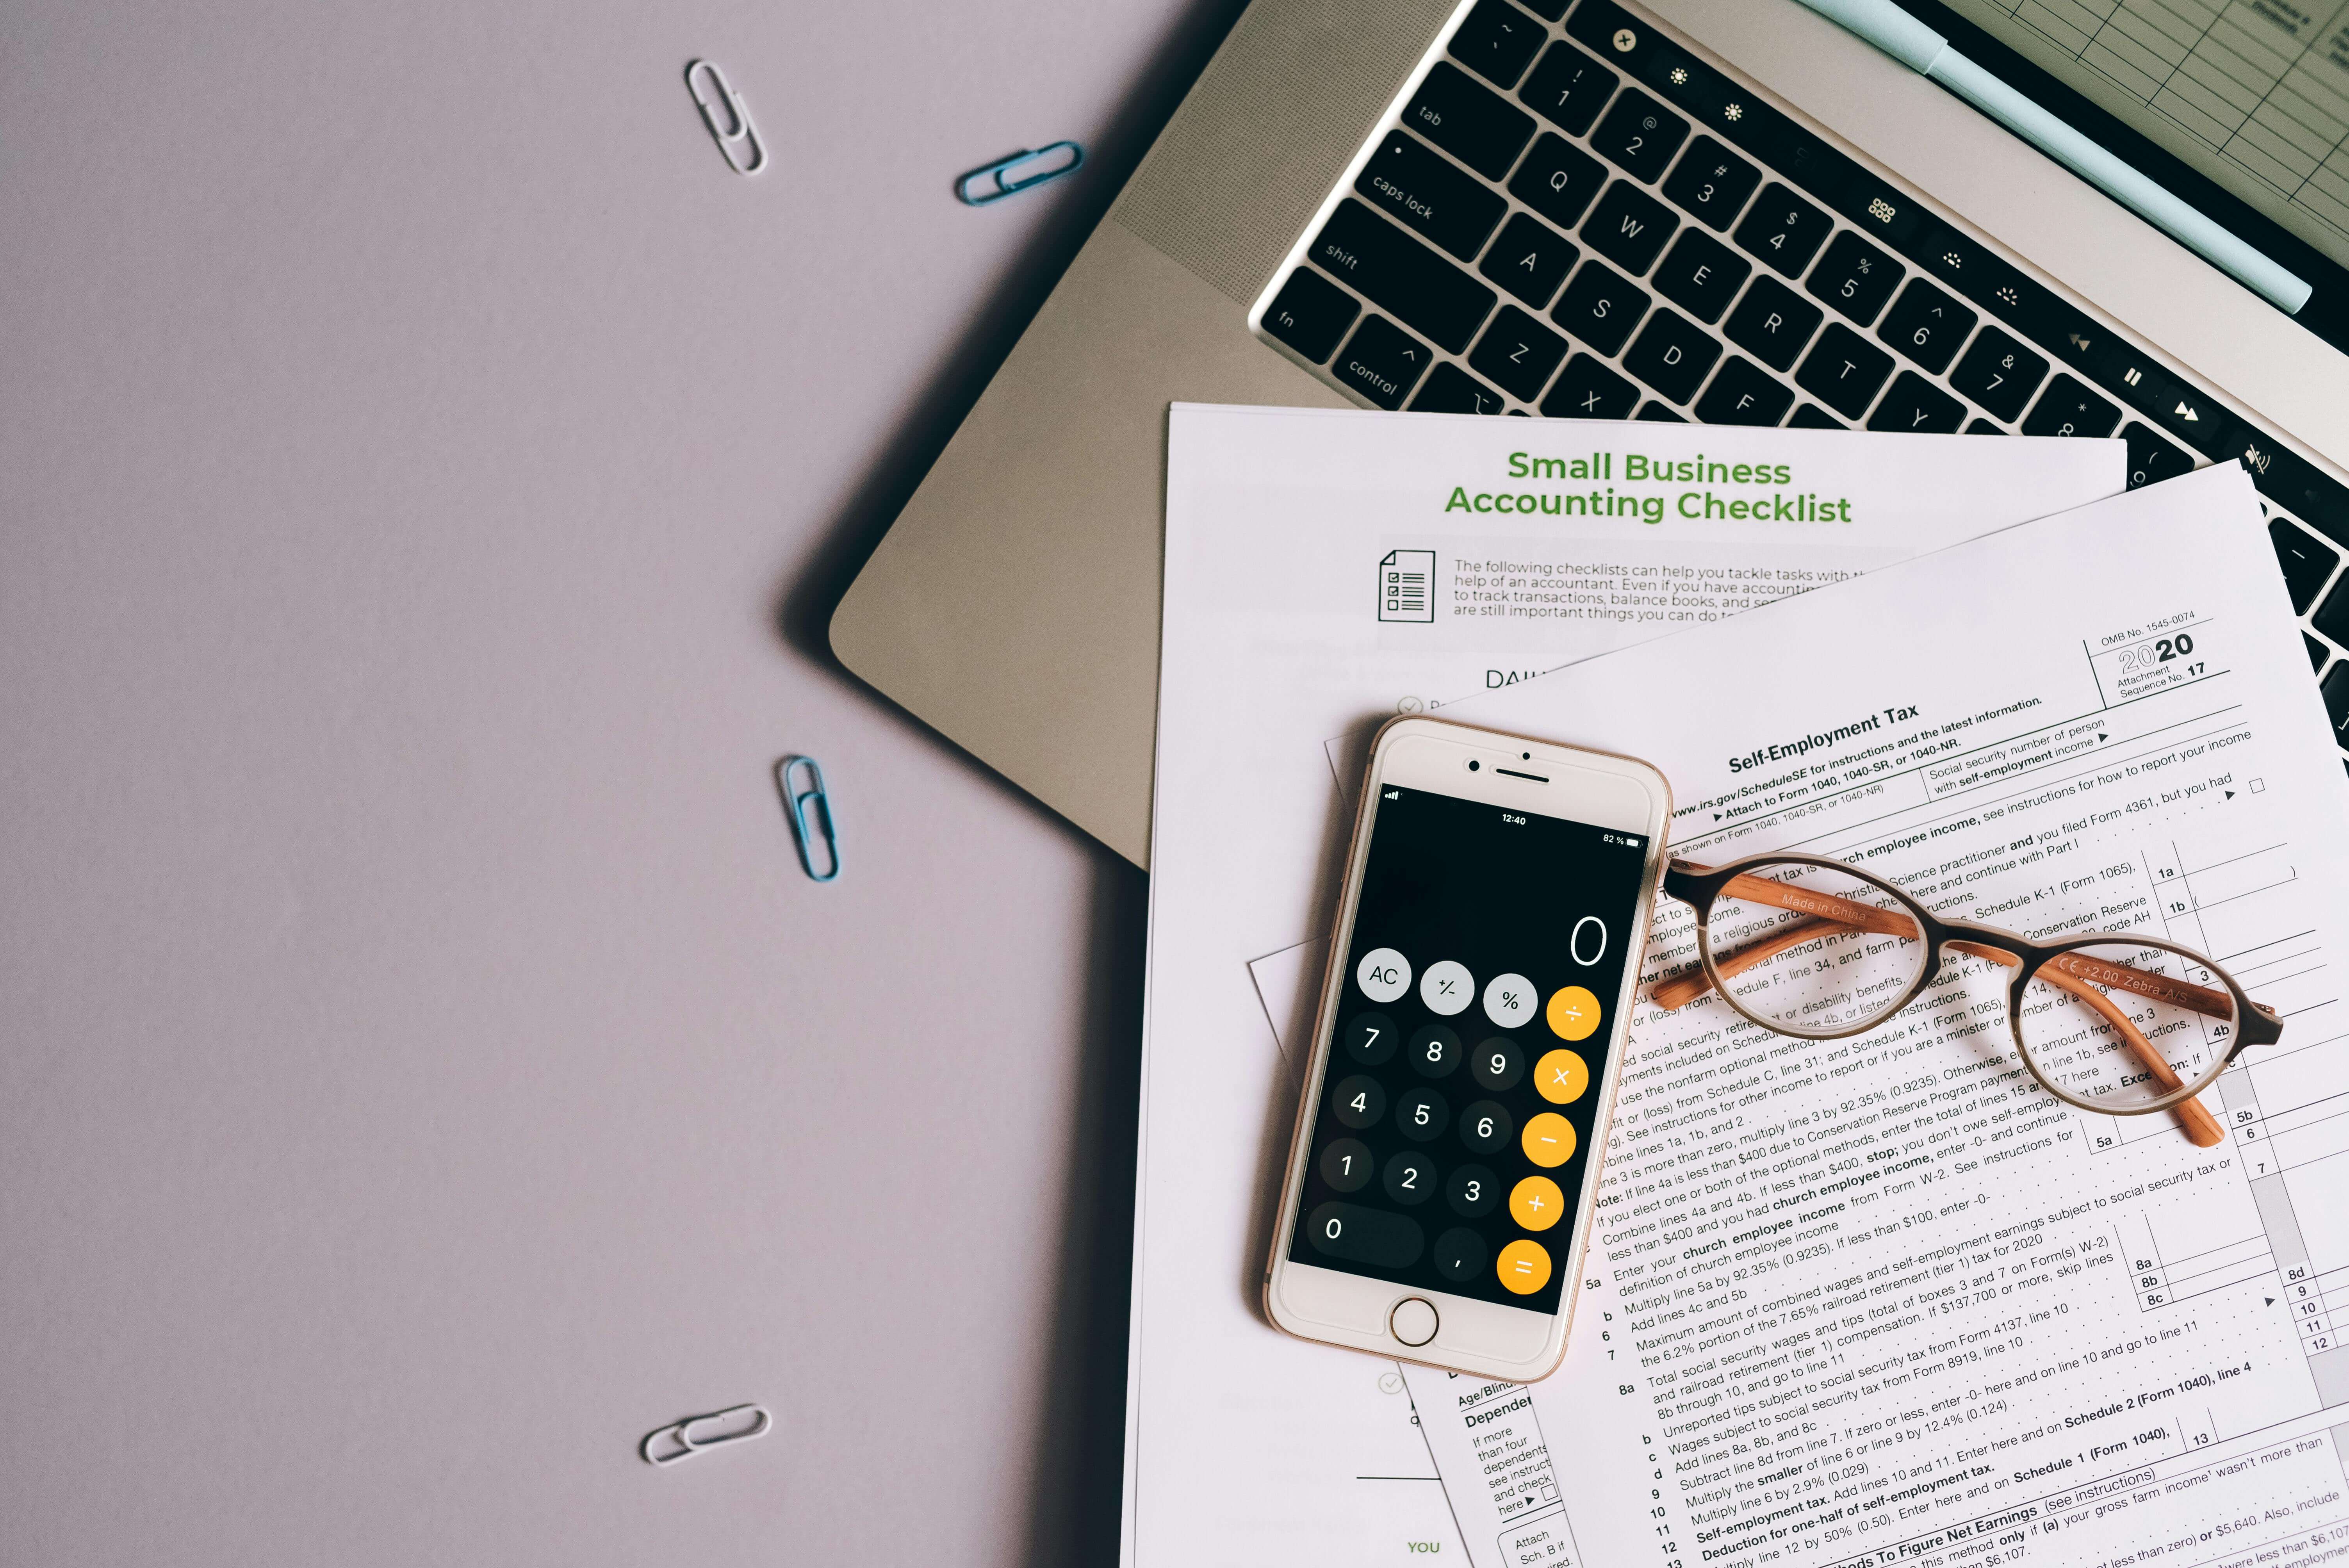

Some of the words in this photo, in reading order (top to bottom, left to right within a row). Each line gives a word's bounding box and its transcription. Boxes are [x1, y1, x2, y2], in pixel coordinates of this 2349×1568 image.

[1558, 91, 1569, 106] 1
[1420, 107, 1441, 125] tab
[1626, 137, 1643, 155] 2
[1551, 171, 1567, 192] Q
[1373, 177, 1404, 201] caps
[1405, 195, 1433, 220] lock
[1698, 184, 1714, 202] 3
[1621, 215, 1644, 238] W
[1770, 234, 1786, 249] 4
[1326, 246, 1358, 270] shift
[1520, 253, 1536, 271] A
[1693, 265, 1711, 285] E
[1841, 279, 1858, 297] 5
[1593, 299, 1610, 317] S
[1279, 312, 1293, 327] fn
[1764, 313, 1782, 333] R
[1914, 328, 1930, 345] 6
[1510, 343, 1529, 363] Z
[1663, 346, 1681, 365] D
[1349, 361, 1397, 396] control
[1841, 360, 1856, 379] T
[1987, 374, 2003, 390] 7
[1581, 391, 1601, 412] X
[1736, 394, 1754, 410] F
[1912, 408, 1928, 427] Y
[1508, 452, 1611, 480] Small
[1626, 454, 1791, 485] Business
[1445, 487, 1664, 524] Accounting
[1678, 492, 1851, 523] Checklist
[1454, 560, 1482, 572] The
[1486, 561, 1552, 577] following
[1556, 563, 1628, 576] checklists
[1632, 567, 1657, 576] can
[1663, 565, 1694, 580] help
[1698, 569, 1724, 581] you
[1728, 567, 1772, 580] tackle
[1776, 569, 1813, 581] tasks
[1454, 606, 1476, 615] are
[1480, 604, 1504, 616] still
[1510, 607, 1583, 619] important
[1588, 607, 1634, 622] things
[1637, 611, 1663, 623] you
[1668, 611, 1694, 621] can
[1698, 610, 1717, 622] do
[2101, 633, 2125, 646] OMB
[2127, 629, 2144, 638] No.
[2146, 611, 2195, 632] 1545-0074
[2119, 634, 2193, 674] 2020
[2118, 665, 2170, 688] Attachment
[2120, 679, 2166, 698] Sequence
[2168, 674, 2185, 683] No.
[2187, 662, 2204, 676] 17
[1729, 715, 1881, 773] Self-Employment
[1883, 705, 1919, 724] Tax
[1810, 764, 1826, 775] for
[1828, 743, 1895, 769] instructions
[1897, 734, 1918, 748] and
[1920, 729, 1939, 740] the
[1941, 717, 1973, 734] latest
[1975, 698, 2042, 723] information.
[1930, 762, 1962, 780] Social
[1966, 750, 2006, 769] security
[2010, 736, 2050, 755] number
[2055, 730, 2064, 741] of
[2069, 720, 2105, 739] person
[1934, 781, 1957, 794] with
[1959, 750, 2053, 786] self-employment
[2054, 739, 2094, 756] income
[1726, 801, 1762, 819] Attach
[1764, 798, 1776, 806] to
[1778, 788, 1808, 802] Form
[1811, 777, 1841, 791] 1040,
[1843, 760, 1893, 781] 1040-SR,
[1896, 756, 1907, 765] or
[1910, 739, 1961, 760] 1040-NR.
[1502, 813, 1526, 825] 12:40
[1603, 834, 1614, 843] 82
[1616, 837, 1624, 845] %
[2158, 869, 2174, 878] 1a
[1782, 893, 1815, 910] Made
[1817, 902, 1828, 912] in
[1832, 905, 1866, 921] China
[2169, 902, 2185, 913] 1b
[1570, 916, 1607, 966] 0
[1369, 966, 1398, 985] AC
[2083, 966, 2118, 982] +2.00
[2123, 976, 2160, 995] Zebra
[2164, 988, 2187, 1002] A/S
[1365, 1028, 1379, 1048] 7
[1427, 1041, 1442, 1062] 8
[1490, 1054, 1506, 1074] 9
[1351, 1092, 1366, 1112] 4
[1415, 1104, 1430, 1125] 5
[2237, 1110, 2253, 1123] 5b
[1477, 1117, 1493, 1138] 6
[2097, 1137, 2112, 1147] 5a
[1342, 1156, 1351, 1175] 1
[1401, 1168, 1417, 1189] 2
[1465, 1181, 1480, 1201] 3
[1326, 1219, 1341, 1239] 0
[2136, 1260, 2152, 1270] 8a
[2288, 1267, 2305, 1280] 8d
[1631, 1316, 1655, 1333] Add
[1657, 1310, 1685, 1324] lines
[1689, 1304, 1703, 1314] 4c
[1706, 1293, 1729, 1309] and
[1731, 1289, 1747, 1301] 5b
[1473, 1437, 1481, 1448] If
[1483, 1428, 1512, 1444] more
[2193, 1433, 2208, 1445] 13
[1478, 1447, 1503, 1461] than
[1505, 1437, 1527, 1451] four
[1697, 1502, 1804, 1543] Self-employment
[1806, 1497, 1830, 1509] tax.
[1834, 1484, 1858, 1501] Add
[1861, 1478, 1888, 1492] lines
[1891, 1470, 1906, 1482] 10
[1910, 1461, 1932, 1477] and
[1936, 1456, 1954, 1468] 11.
[1957, 1445, 1988, 1462] Enter
[1991, 1437, 2018, 1452] here
[2021, 1426, 2044, 1442] and
[2047, 1423, 2062, 1434] on
[2064, 1404, 2123, 1428] Schedule
[2126, 1398, 2135, 1409] 2
[2137, 1388, 2174, 1408] (Form
[2177, 1374, 2215, 1392] 1040),
[2217, 1368, 2240, 1381] line
[2244, 1361, 2252, 1371] 4
[1489, 1476, 1508, 1488] see
[1494, 1486, 1515, 1502] and
[1518, 1474, 1552, 1493] check
[1498, 1501, 1524, 1516] here
[1876, 1551, 1895, 1563] To
[1898, 1537, 1944, 1557] Figure
[1946, 1525, 1973, 1542] Net
[1975, 1507, 2037, 1533] Earnings
[2045, 1496, 2072, 1514] (see
[2075, 1467, 2155, 1502] instructions)
[2110, 1556, 2135, 1568] less
[2137, 1547, 2164, 1561] than
[2167, 1534, 2196, 1552] zero)
[2200, 1531, 2212, 1541] or
[2216, 1516, 2260, 1537] $5,640.
[2265, 1507, 2293, 1522] Also,
[2296, 1492, 2339, 1511] include
[1408, 1542, 1440, 1554] YOU
[1516, 1531, 1549, 1550] Attach
